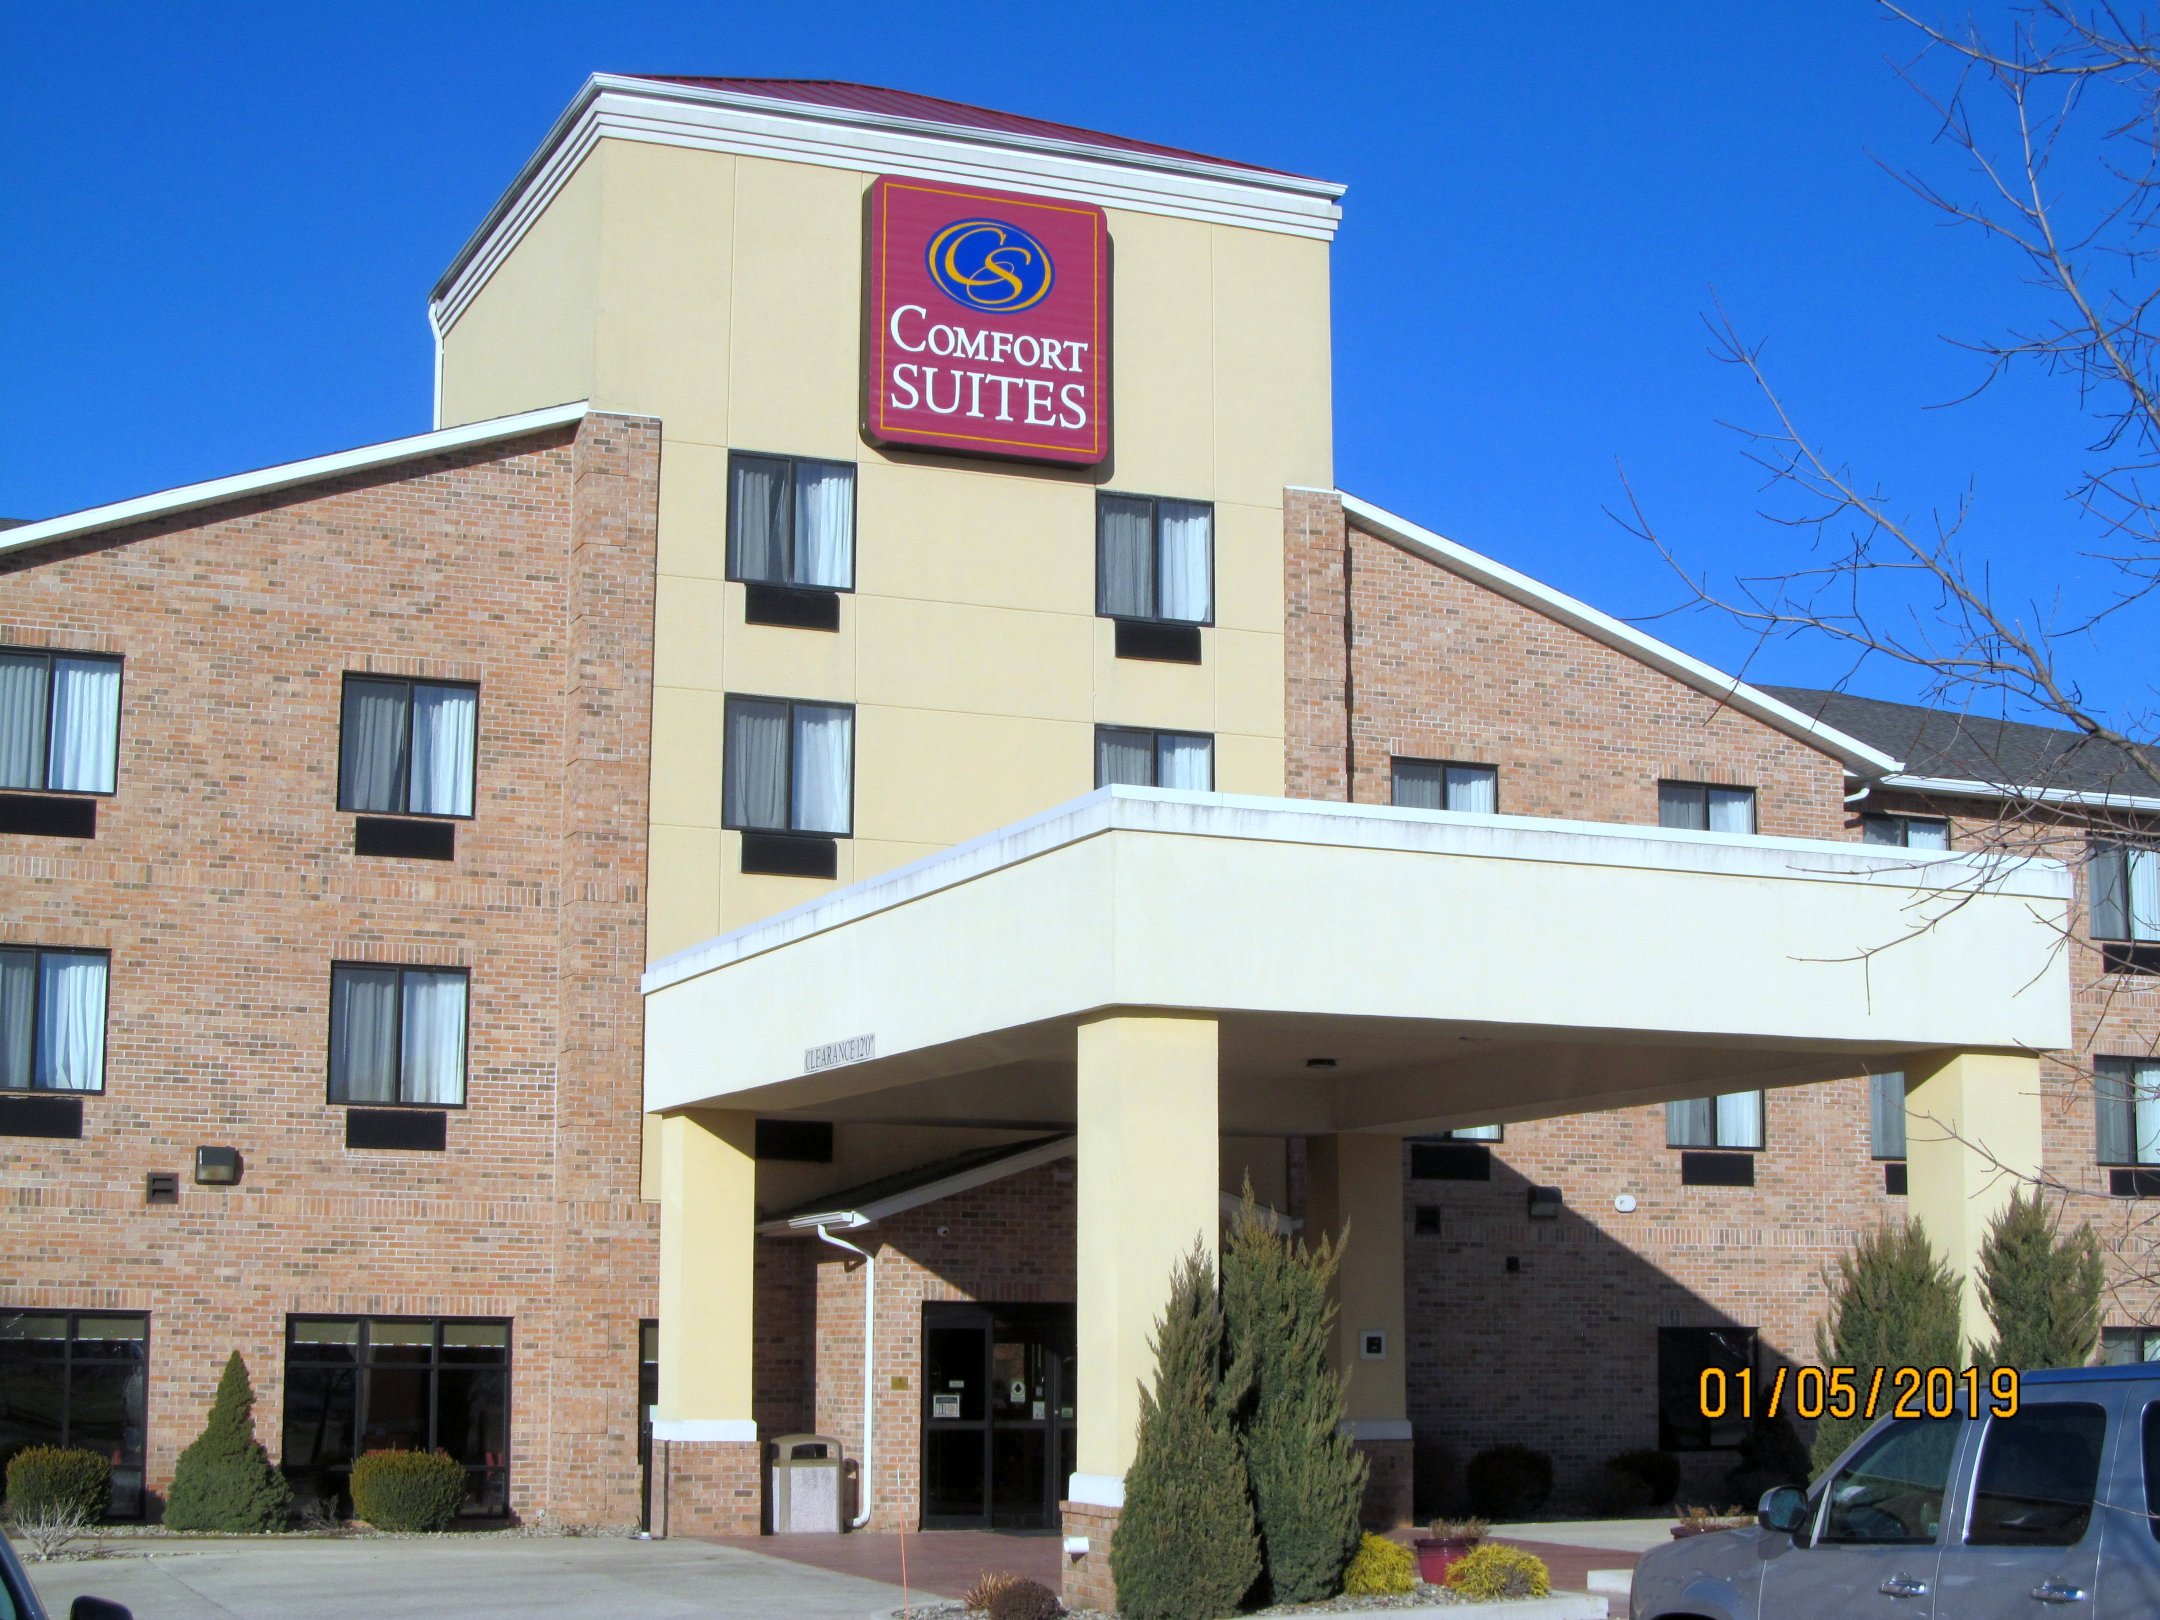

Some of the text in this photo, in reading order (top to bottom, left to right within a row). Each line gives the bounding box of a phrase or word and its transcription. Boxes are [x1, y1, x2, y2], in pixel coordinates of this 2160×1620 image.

[890, 305, 1088, 372] COMFORT
[891, 363, 1087, 429] SUITES
[805, 1040, 854, 1070] CLEARANCE
